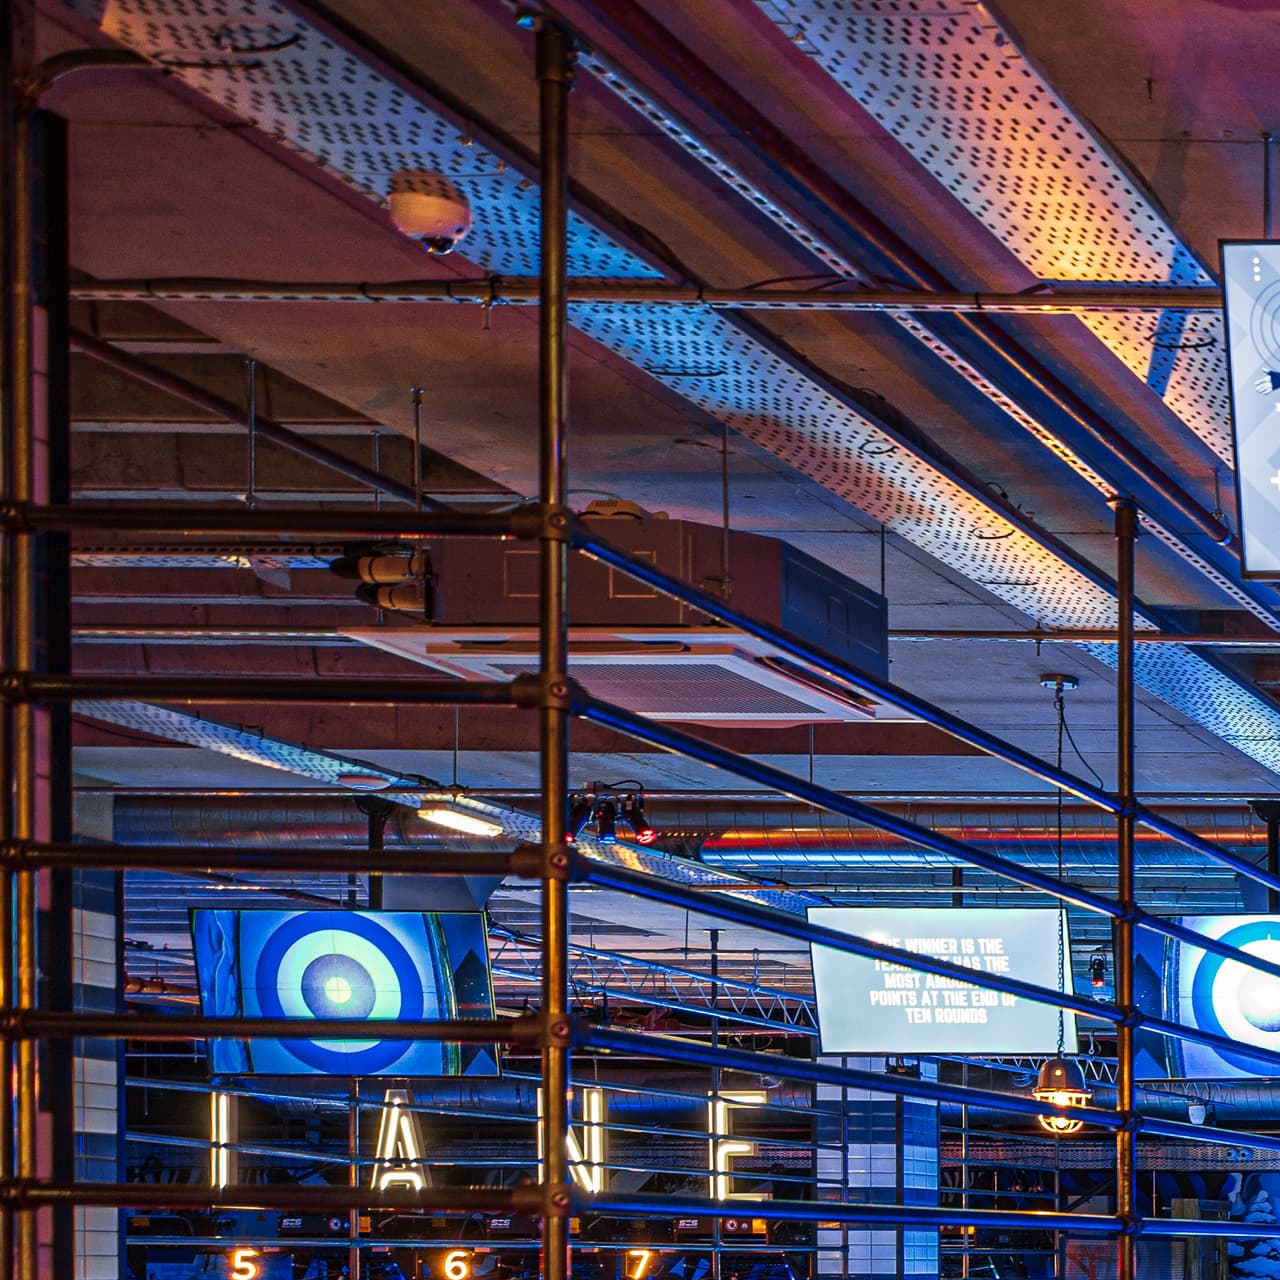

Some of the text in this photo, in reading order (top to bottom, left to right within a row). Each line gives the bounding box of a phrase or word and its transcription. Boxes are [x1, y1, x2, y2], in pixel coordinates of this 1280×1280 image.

[905, 937, 957, 954] WINNER
[960, 937, 975, 954] IS
[977, 937, 1005, 954] THE
[984, 955, 1010, 972] THE
[884, 973, 920, 989] MOST
[870, 990, 917, 1007] POINTS
[921, 990, 938, 1007] AT
[942, 990, 969, 1007] THE
[971, 990, 999, 1007] END
[905, 1007, 988, 1024] TEN ROUNDS
[231, 1250, 257, 1280] 5
[445, 1250, 468, 1280] 6
[630, 1250, 651, 1280] 7
